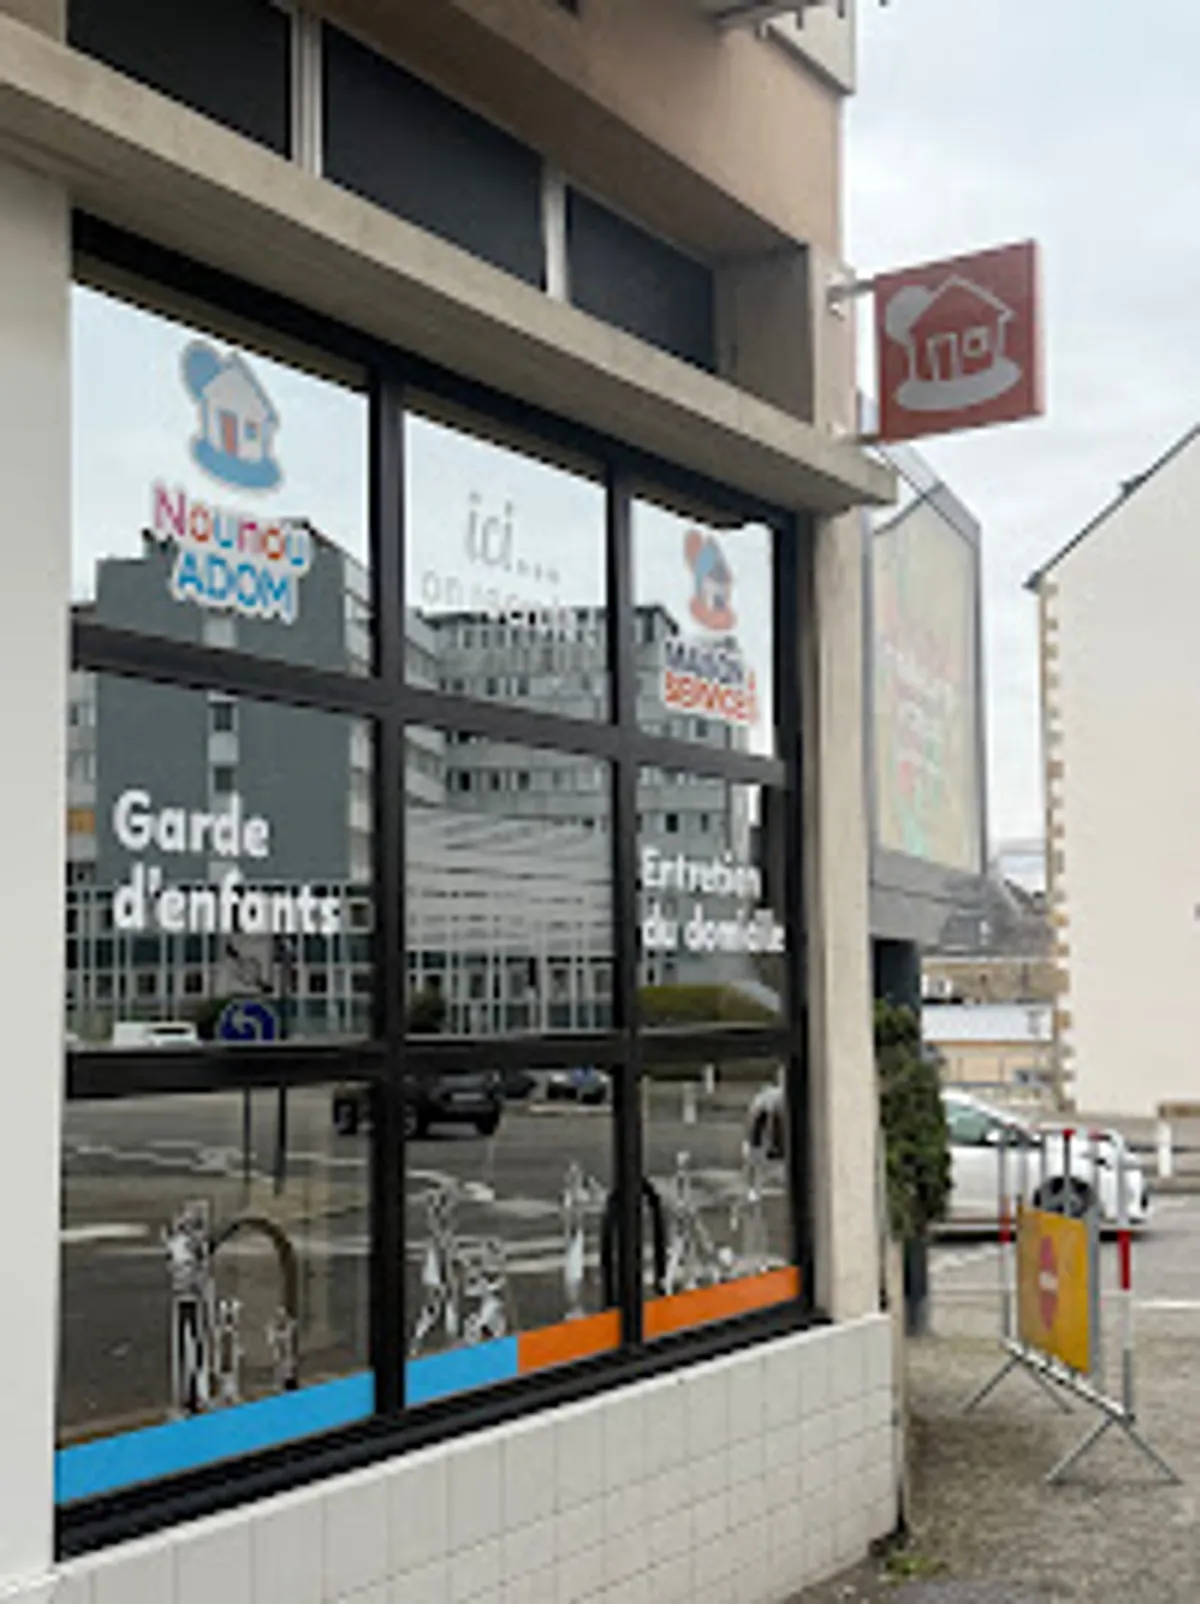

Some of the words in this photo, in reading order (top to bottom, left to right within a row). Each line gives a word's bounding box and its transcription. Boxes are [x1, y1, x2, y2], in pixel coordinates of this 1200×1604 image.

[154, 479, 307, 567] Nounou
[177, 551, 293, 618] ADOM
[113, 788, 270, 857] Garde
[113, 861, 341, 935] d'enfants
[642, 902, 678, 948] du
